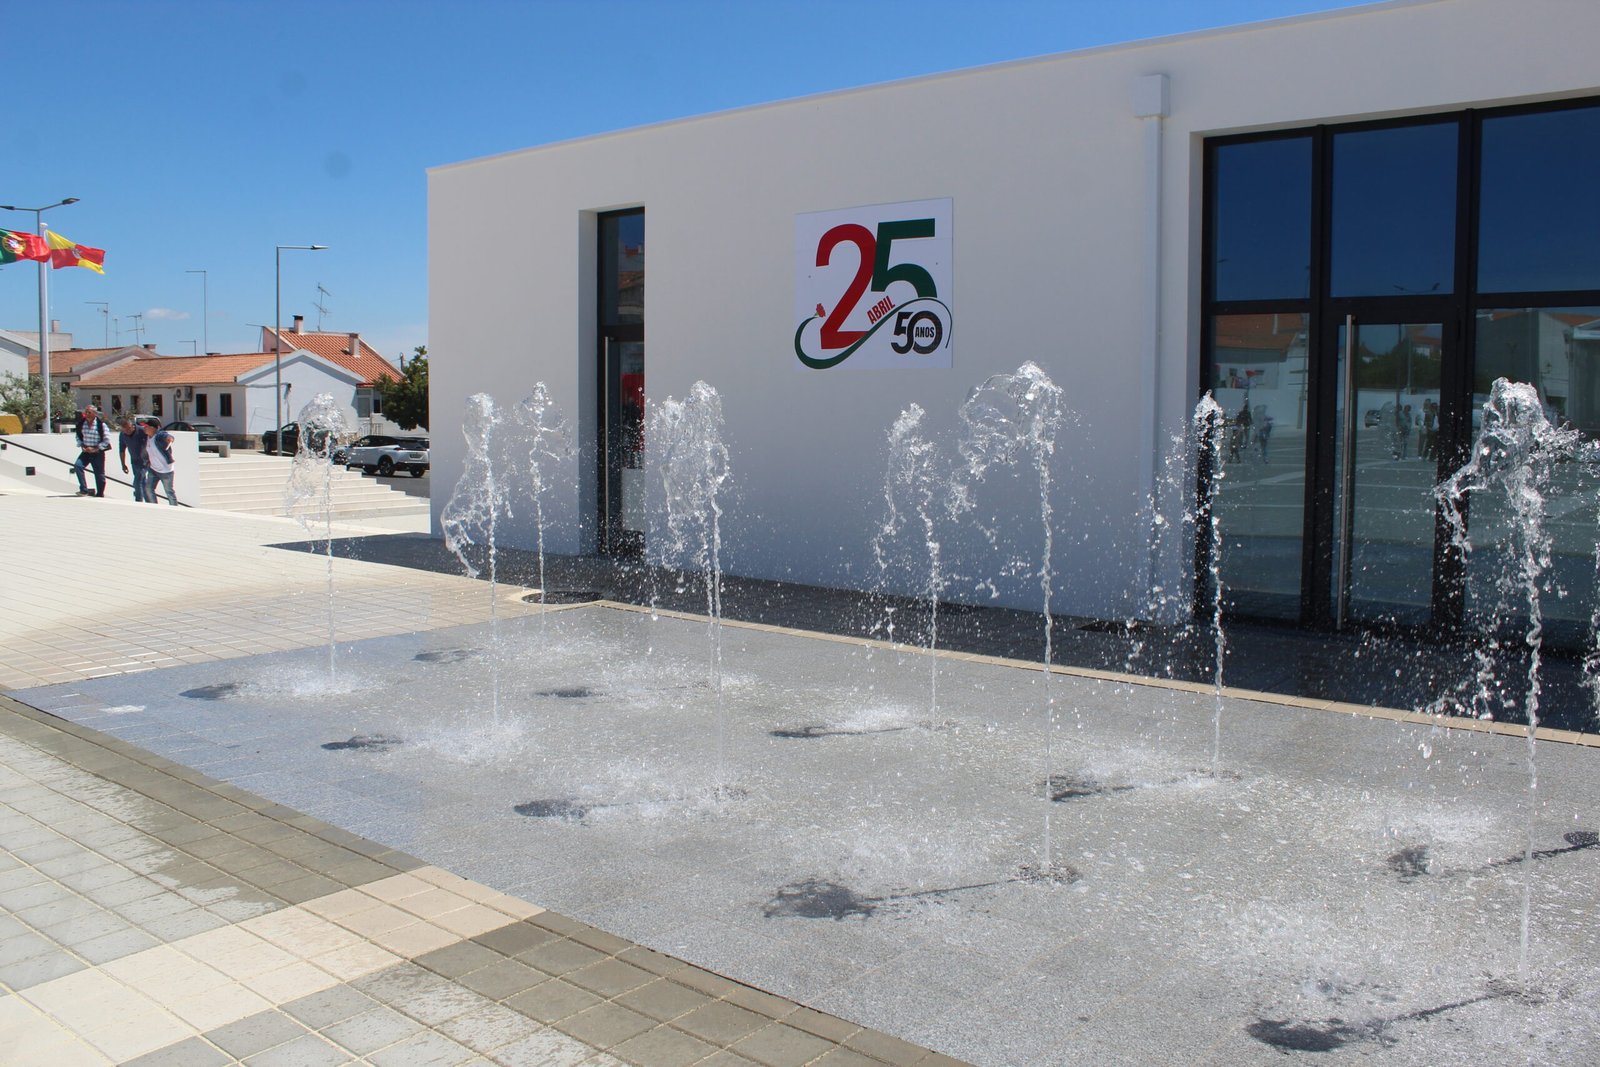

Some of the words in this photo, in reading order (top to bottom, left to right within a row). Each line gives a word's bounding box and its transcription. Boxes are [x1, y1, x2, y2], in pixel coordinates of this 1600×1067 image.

[816, 218, 937, 349] 25
[867, 296, 895, 324] ABRIL
[891, 311, 943, 354] 50
[915, 326, 935, 338] ANOS
